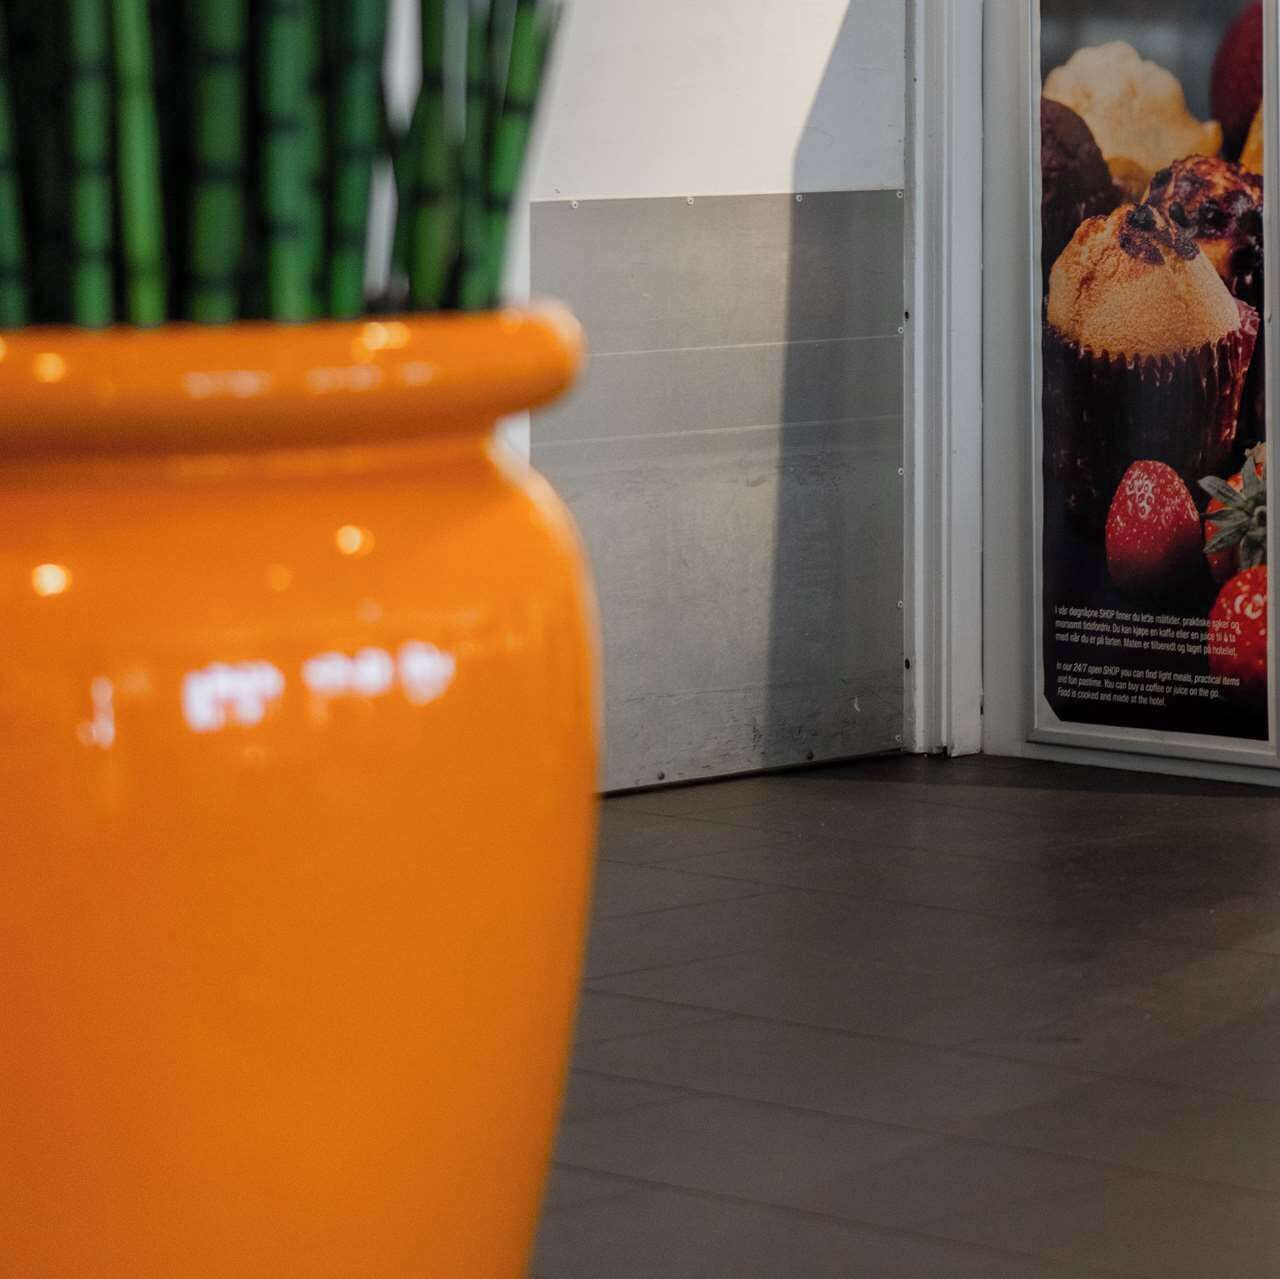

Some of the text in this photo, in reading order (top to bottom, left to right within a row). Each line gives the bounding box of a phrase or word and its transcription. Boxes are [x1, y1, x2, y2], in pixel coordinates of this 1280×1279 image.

[1072, 662, 1088, 673] 24/7
[1120, 668, 1132, 679] you
[1132, 669, 1144, 679] can
[1194, 674, 1221, 685] practical
[1057, 686, 1071, 697] Food
[1077, 690, 1099, 700] cooked
[1100, 691, 1112, 702] and
[1112, 693, 1130, 704] made
[1138, 695, 1148, 705] the
[1103, 679, 1115, 689] You
[1115, 681, 1127, 690] can
[1128, 681, 1139, 693] buy
[1145, 682, 1165, 693] coffee
[1198, 687, 1209, 697] the
